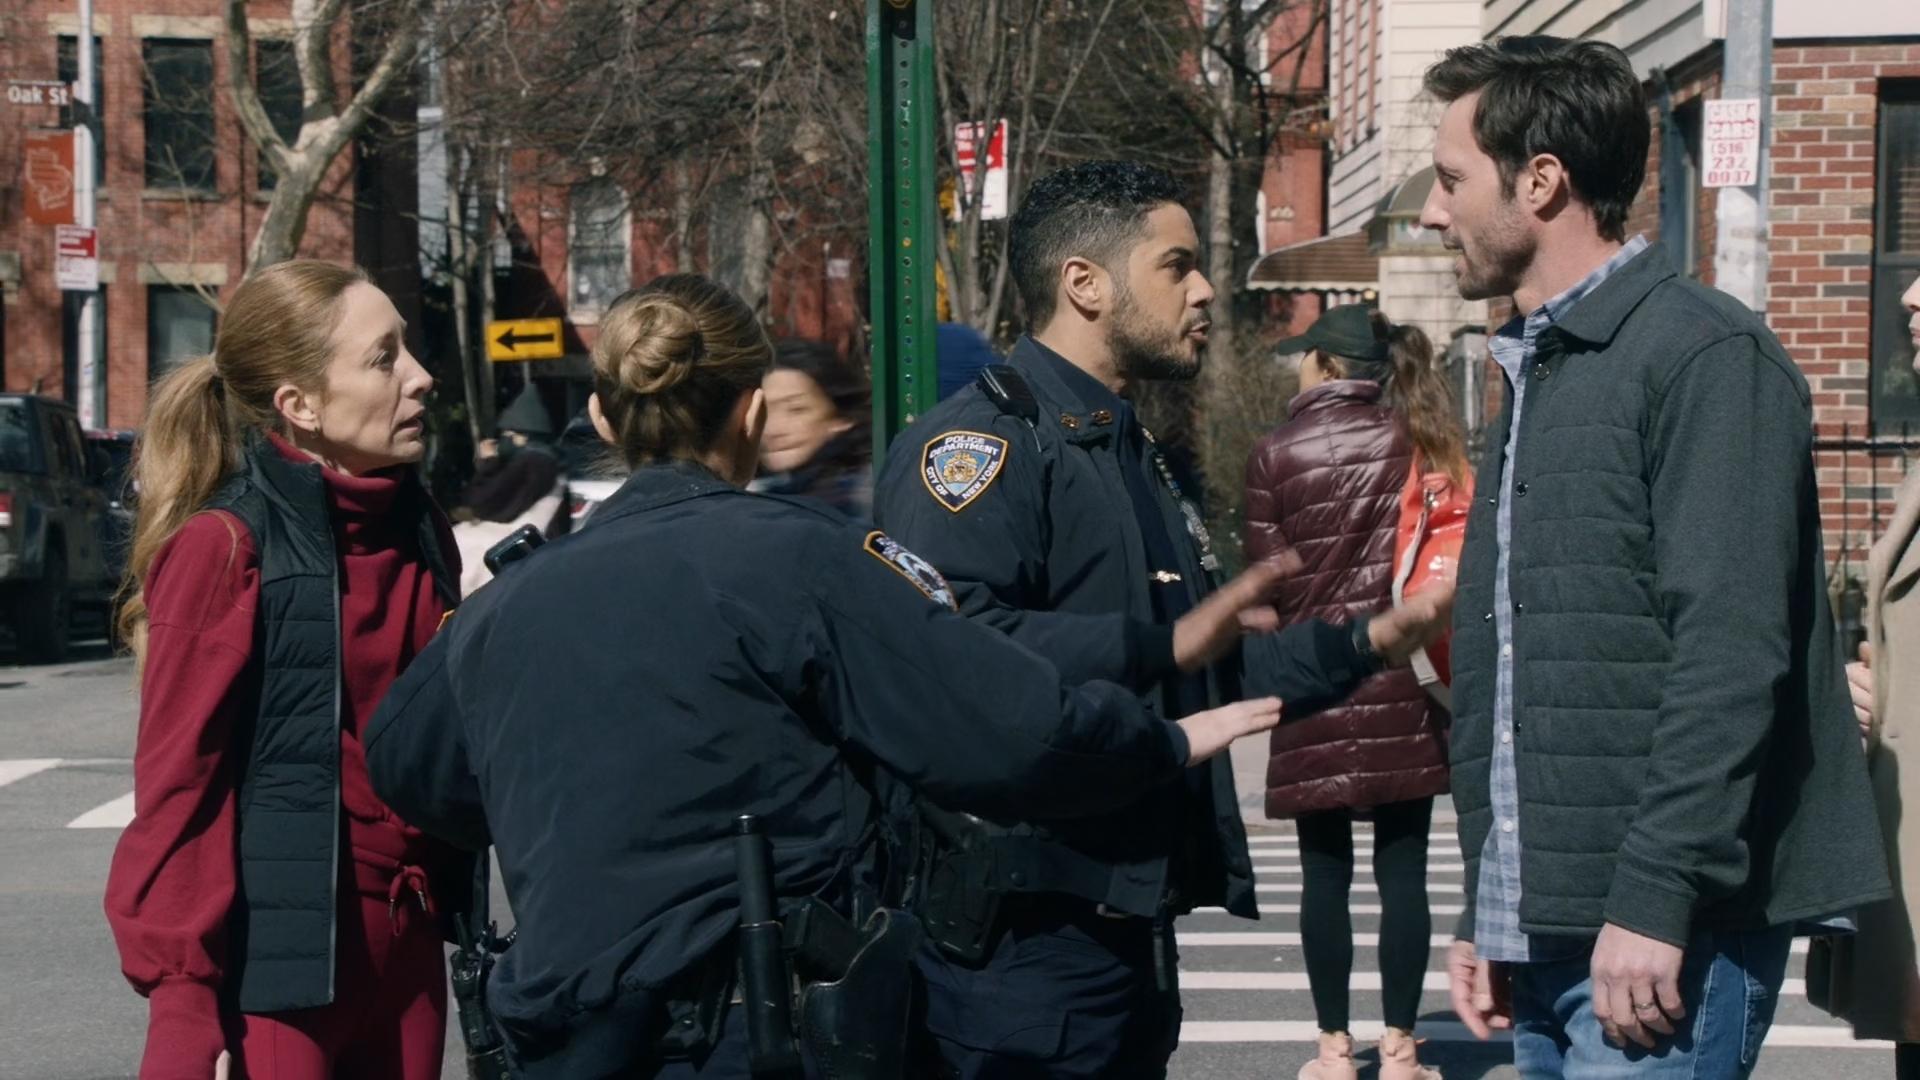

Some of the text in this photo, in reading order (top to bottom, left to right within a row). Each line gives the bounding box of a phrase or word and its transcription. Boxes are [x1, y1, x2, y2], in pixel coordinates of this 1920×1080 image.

[8, 85, 69, 105] Oak St
[944, 435, 985, 445] POLICE
[929, 443, 999, 458] DEPARTMENT
[926, 466, 949, 496] CITY OF
[962, 461, 999, 499] NEW YORK
